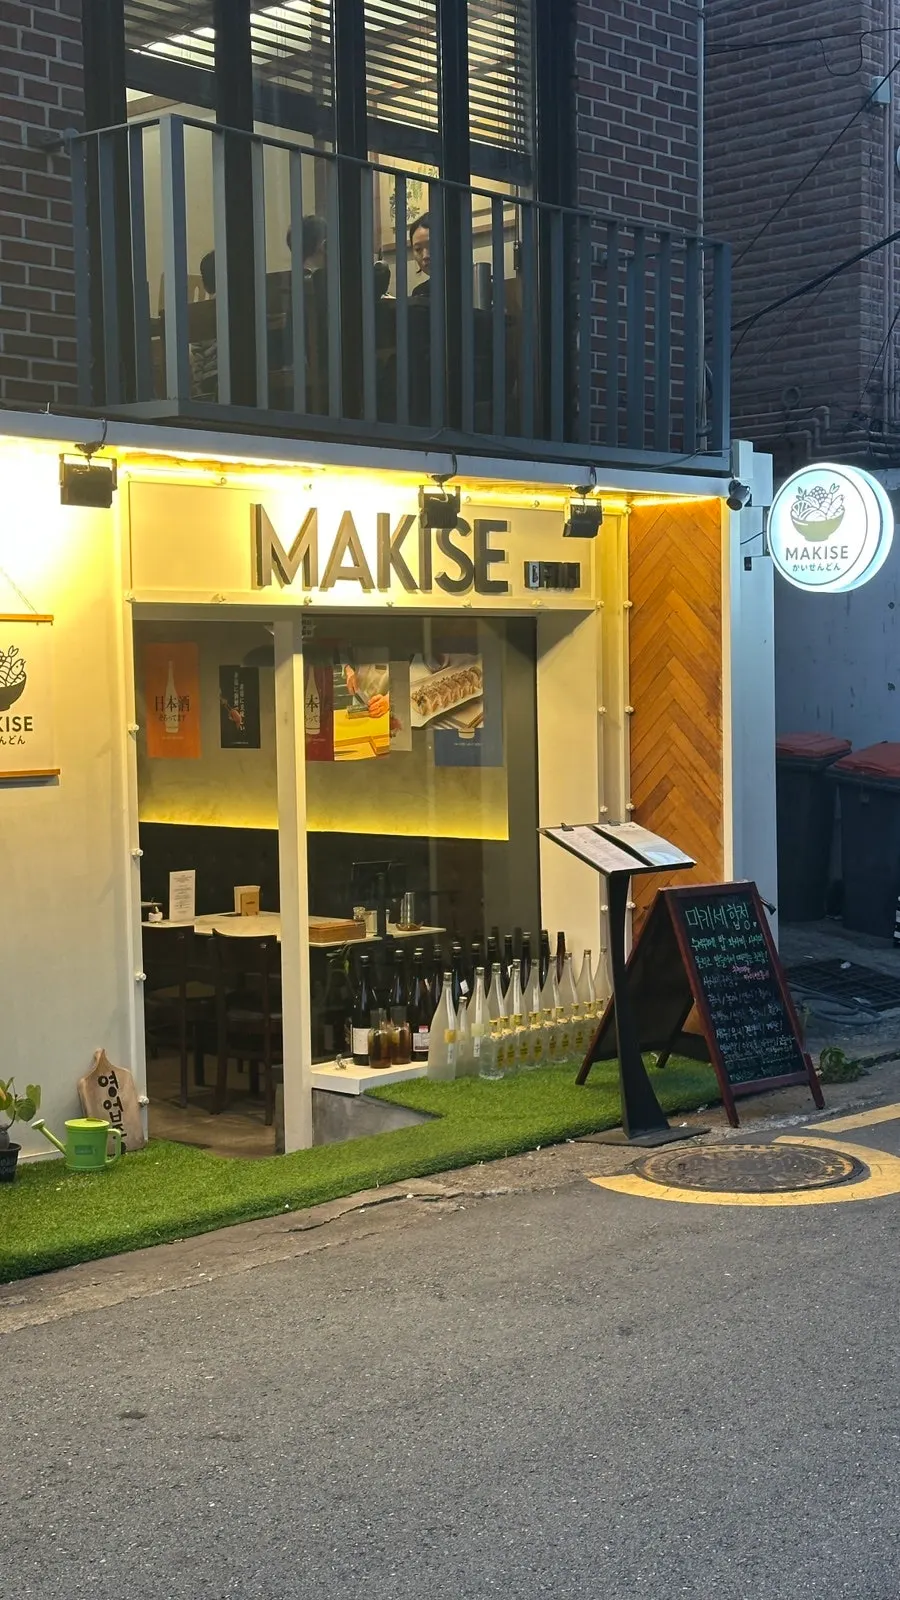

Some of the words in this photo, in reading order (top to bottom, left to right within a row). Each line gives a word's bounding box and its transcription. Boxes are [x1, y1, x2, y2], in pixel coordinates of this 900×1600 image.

[250, 503, 510, 595] MAKISE
[785, 545, 849, 561] MAKISE
[792, 562, 841, 572] かいせんどん
[155, 695, 190, 712] 日本酒
